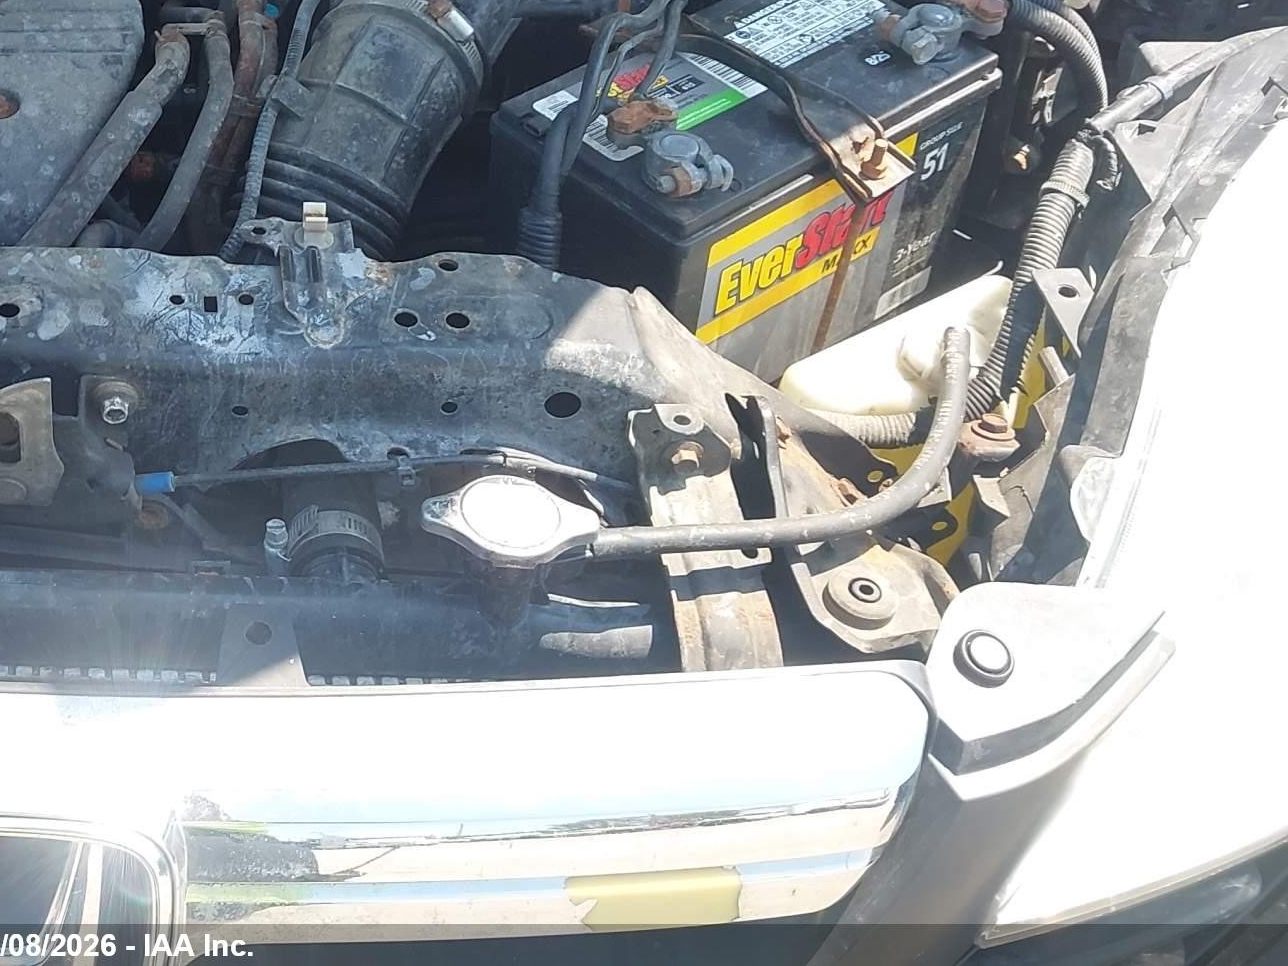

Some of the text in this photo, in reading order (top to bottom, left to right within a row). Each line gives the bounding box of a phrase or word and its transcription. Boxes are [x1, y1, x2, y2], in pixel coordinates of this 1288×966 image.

[920, 142, 949, 181] 51
[821, 235, 872, 274] MXX
[893, 231, 937, 264] 3-Year
